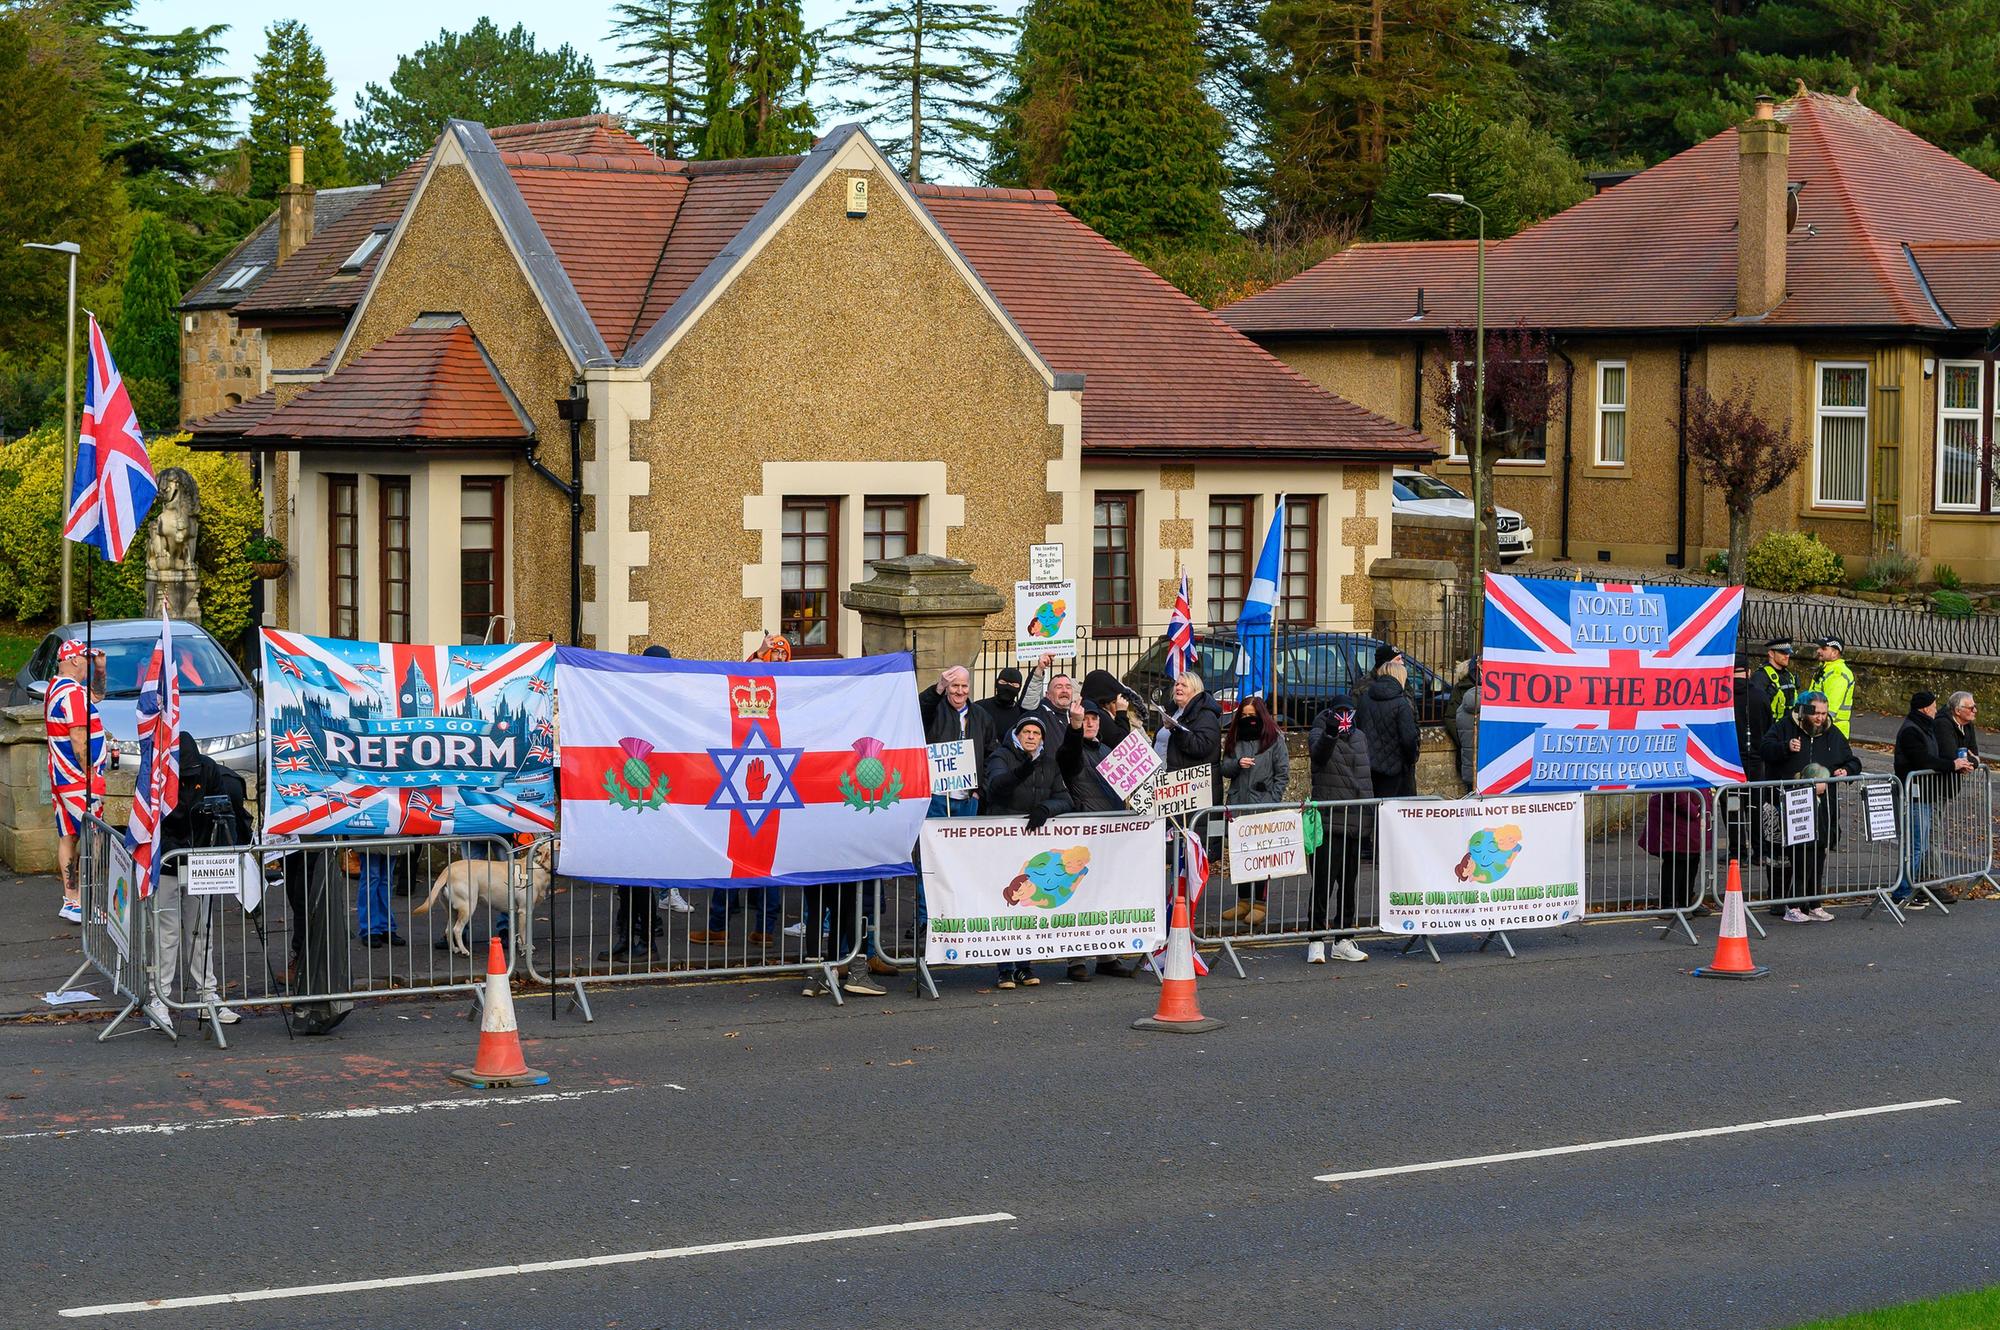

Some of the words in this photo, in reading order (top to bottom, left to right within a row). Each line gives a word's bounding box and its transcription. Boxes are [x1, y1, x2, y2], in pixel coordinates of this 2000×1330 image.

[1577, 595, 1634, 616] NONE
[1639, 597, 1659, 617] IN
[1576, 624, 1617, 644] ALL
[1622, 625, 1664, 645] OUT
[1484, 670, 1572, 704] STOP
[1580, 675, 1645, 706] THE
[1654, 675, 1733, 706] BOATS
[376, 719, 436, 733] LET'S
[446, 720, 478, 734] GO,
[322, 729, 518, 769] REFORM
[927, 741, 964, 759] CLOSE
[1112, 733, 1139, 761] SOLD
[1542, 734, 1615, 754] LISTEN
[1616, 734, 1642, 754] TO
[1644, 733, 1677, 753] THE
[935, 757, 957, 772] THE
[1106, 763, 1130, 785] OUR
[1126, 743, 1148, 767] KIDS
[1120, 754, 1155, 792] SAFTEY
[1534, 761, 1612, 781] BRITISH
[1617, 760, 1688, 781] PEOPLE
[1155, 773, 1170, 787] HE
[1176, 764, 1211, 782] CHOSE
[1155, 782, 1190, 801] PROFIT
[1157, 796, 1197, 817] PEOPLE
[1398, 808, 1423, 818] "THE
[1425, 808, 1464, 818] PEOPLE
[1465, 807, 1482, 817] WILL
[1485, 806, 1509, 816] NOT
[1511, 804, 1526, 814] BE
[1528, 801, 1577, 814] SILENCED"
[937, 827, 967, 838] "THE
[969, 826, 1018, 837] PEOPLE
[1021, 826, 1051, 837] WILL
[1054, 826, 1083, 836] NOT
[1083, 825, 1097, 835] BE
[1100, 821, 1155, 834] SILENCED"
[1238, 820, 1296, 838] COMMUNICATION
[1241, 842, 1248, 852] IS
[1256, 838, 1273, 850] KEY
[1279, 836, 1290, 846] TO
[191, 868, 235, 877] HANNIGAN
[1390, 891, 1423, 906] SAVE
[1425, 891, 1446, 906] OUR
[1446, 890, 1479, 905] FUTURE
[1480, 892, 1489, 903] &
[1490, 888, 1514, 902] OUR
[1515, 885, 1545, 901] KIDS
[1545, 882, 1579, 899] FUTURE
[1441, 907, 1470, 915] FALKIRK
[1497, 904, 1529, 912] FUTURE
[931, 917, 966, 933] SAVE
[966, 916, 990, 933] OUR
[991, 915, 1037, 932] FUTURE
[1039, 916, 1049, 929] &
[1051, 913, 1076, 929] OUR
[1077, 911, 1108, 927] KIDS
[1109, 908, 1155, 925] FUTURE
[1421, 920, 1461, 929] FOLLOW
[1481, 918, 1495, 926] ON
[1500, 913, 1559, 925] FACEBOOK
[931, 936, 964, 944] STAND
[985, 934, 1022, 942] FALKIRK
[1056, 930, 1091, 938] FUTURE
[965, 948, 1011, 958] FOLLOW
[1016, 947, 1032, 955] US
[1037, 945, 1054, 954] ON
[1060, 940, 1126, 953] FACEBOOK
